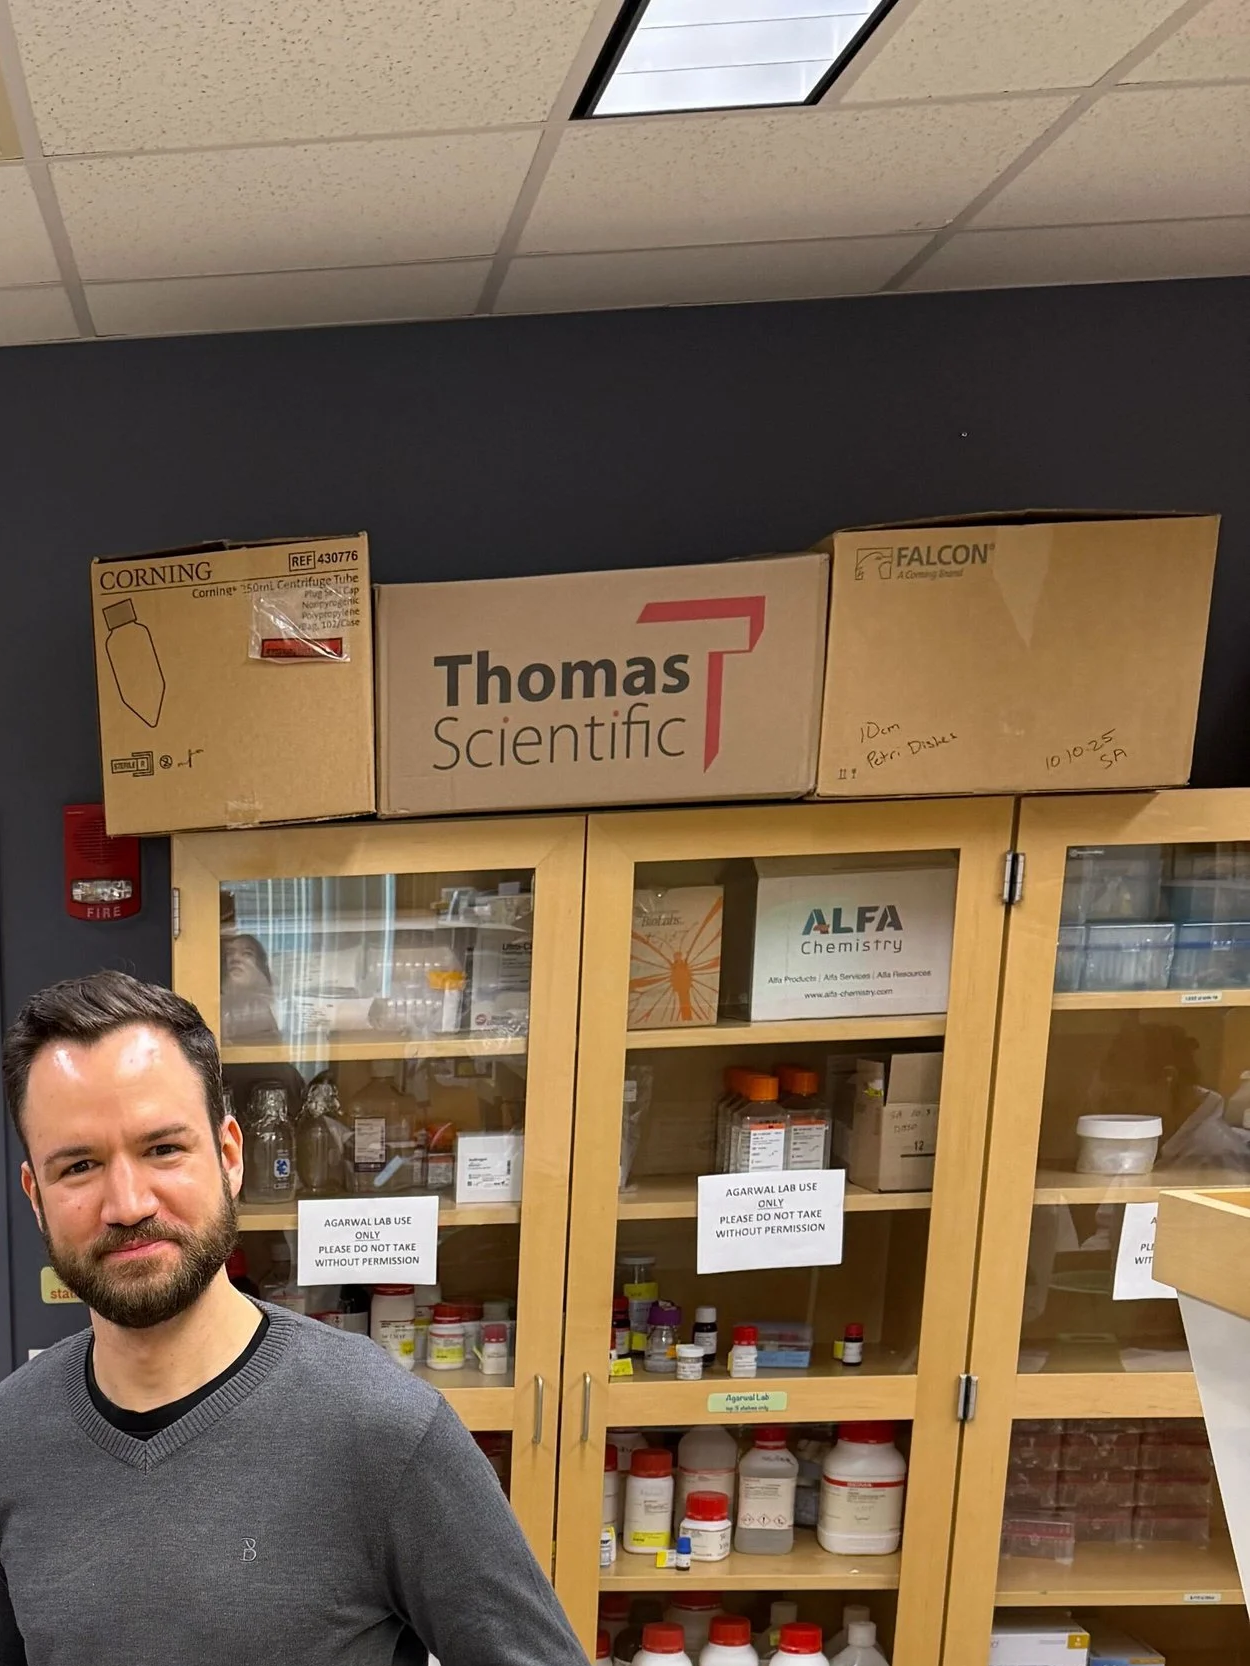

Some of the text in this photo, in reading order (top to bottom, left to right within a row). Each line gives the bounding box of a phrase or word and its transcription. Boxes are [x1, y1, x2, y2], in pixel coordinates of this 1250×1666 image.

[291, 551, 358, 568] REF 430776
[100, 561, 212, 590] CORNING
[277, 575, 332, 590] Centrifuge
[334, 574, 359, 586] Tube
[434, 650, 691, 707] Thomas
[432, 703, 687, 770] Scientific
[1100, 748, 1127, 770] SA
[87, 906, 121, 918] FIRE
[802, 905, 903, 936] ALFA
[801, 939, 903, 955] Chemistry
[784, 975, 817, 984] Products
[726, 1183, 818, 1197] AGARWAL LAB USE
[758, 1198, 784, 1208] ONLY
[324, 1216, 412, 1227] AGARWAL LAB USE
[720, 1209, 822, 1224] PLEASE DO NOT TAKE
[355, 1231, 380, 1240] ONLY
[716, 1223, 825, 1238] WITHOUT PERMISSION
[319, 1243, 416, 1254] PLEASE DO NOT TAKE
[315, 1256, 419, 1267] WITHOUT PERMISSION
[725, 1393, 770, 1404] Agarwal Lab
